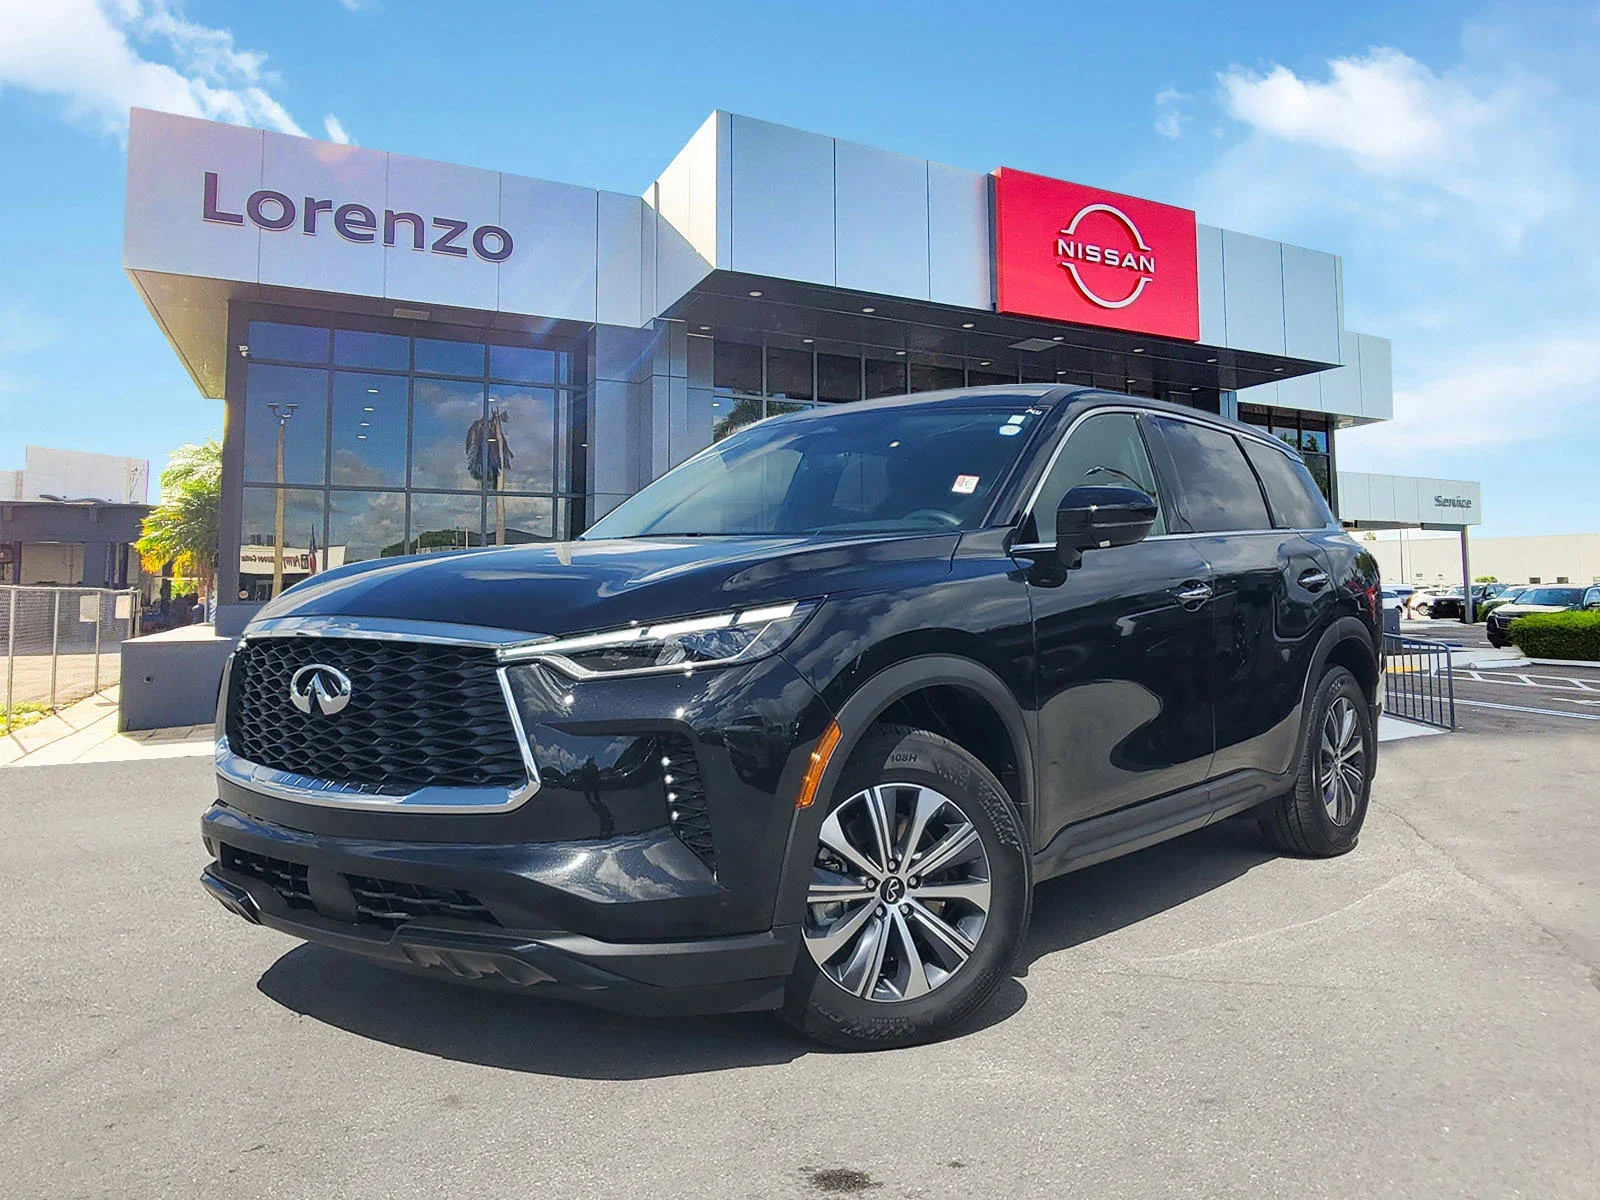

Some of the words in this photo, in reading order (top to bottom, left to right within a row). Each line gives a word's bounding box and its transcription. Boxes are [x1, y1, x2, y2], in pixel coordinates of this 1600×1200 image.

[203, 171, 514, 262] Lorenzo
[1058, 238, 1154, 273] NISSAN
[1434, 495, 1472, 508] Service
[890, 753, 918, 762] 108H
